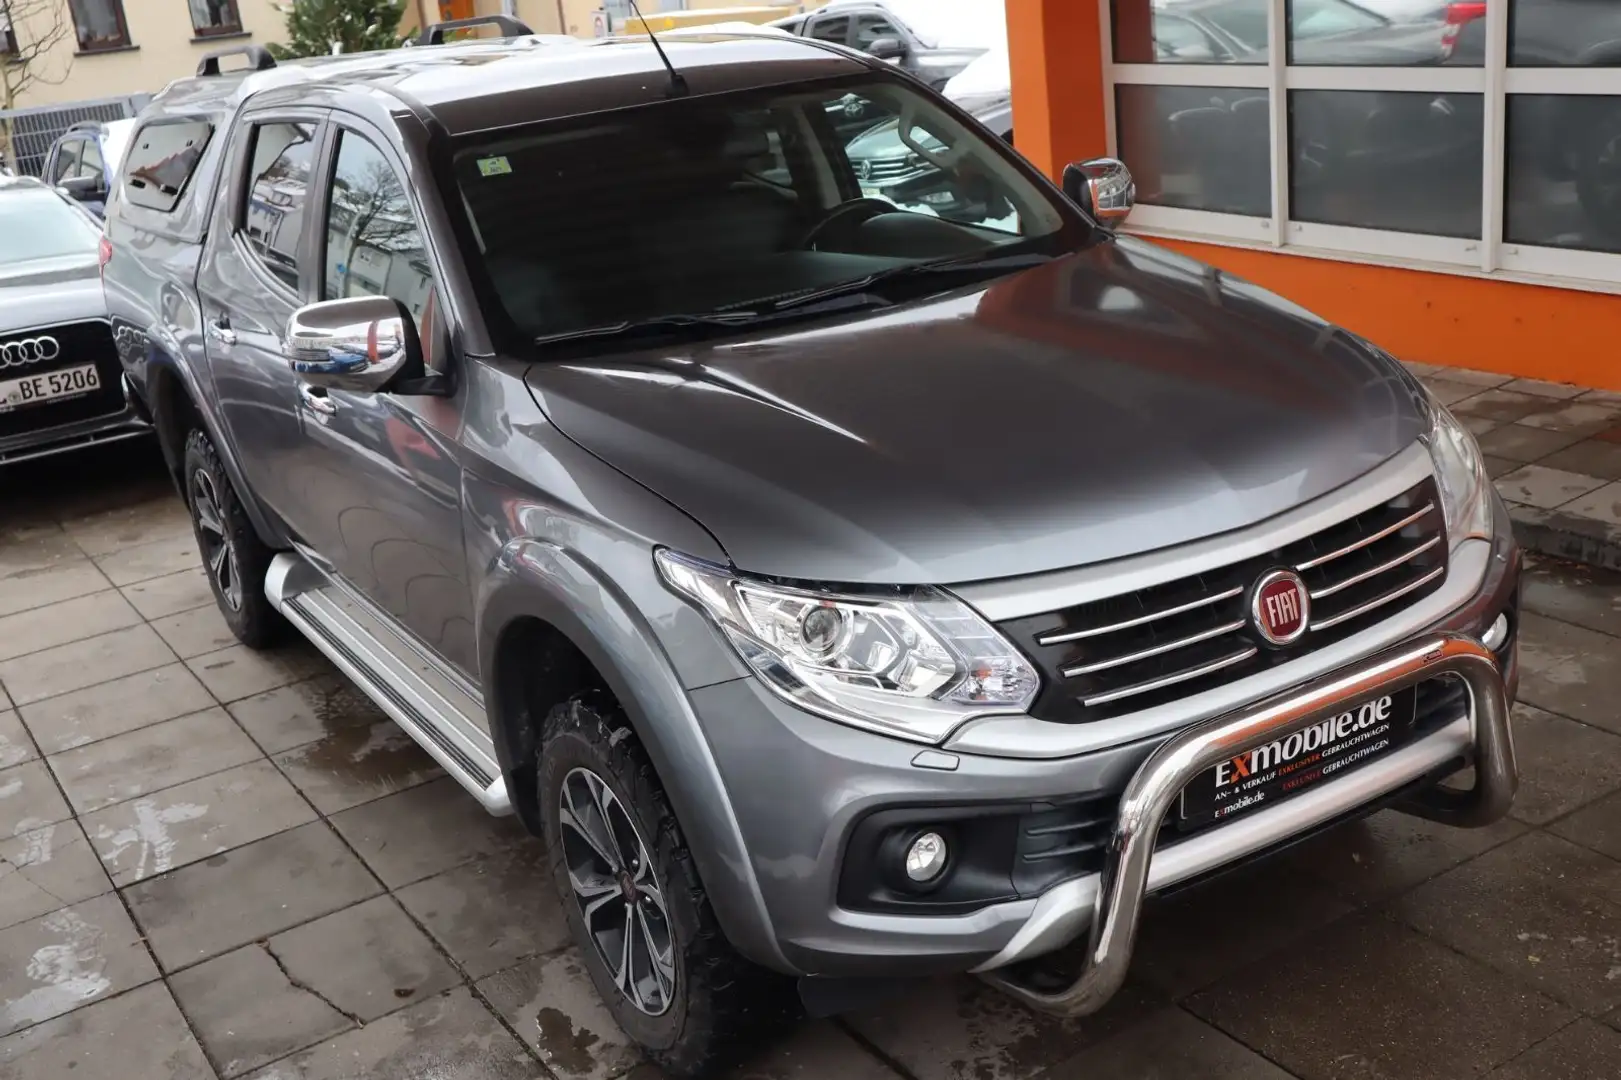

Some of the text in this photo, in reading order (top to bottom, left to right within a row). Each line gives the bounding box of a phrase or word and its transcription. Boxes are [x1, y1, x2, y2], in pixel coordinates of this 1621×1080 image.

[19, 378, 47, 400] BE
[48, 368, 97, 394] 5206
[1266, 588, 1299, 627] FIAT
[1242, 771, 1277, 791] VERKAUF
[1321, 723, 1390, 758] GEBRAUCHTWAGEN
[1322, 738, 1390, 775] GEBRAUCHTWAGEN
